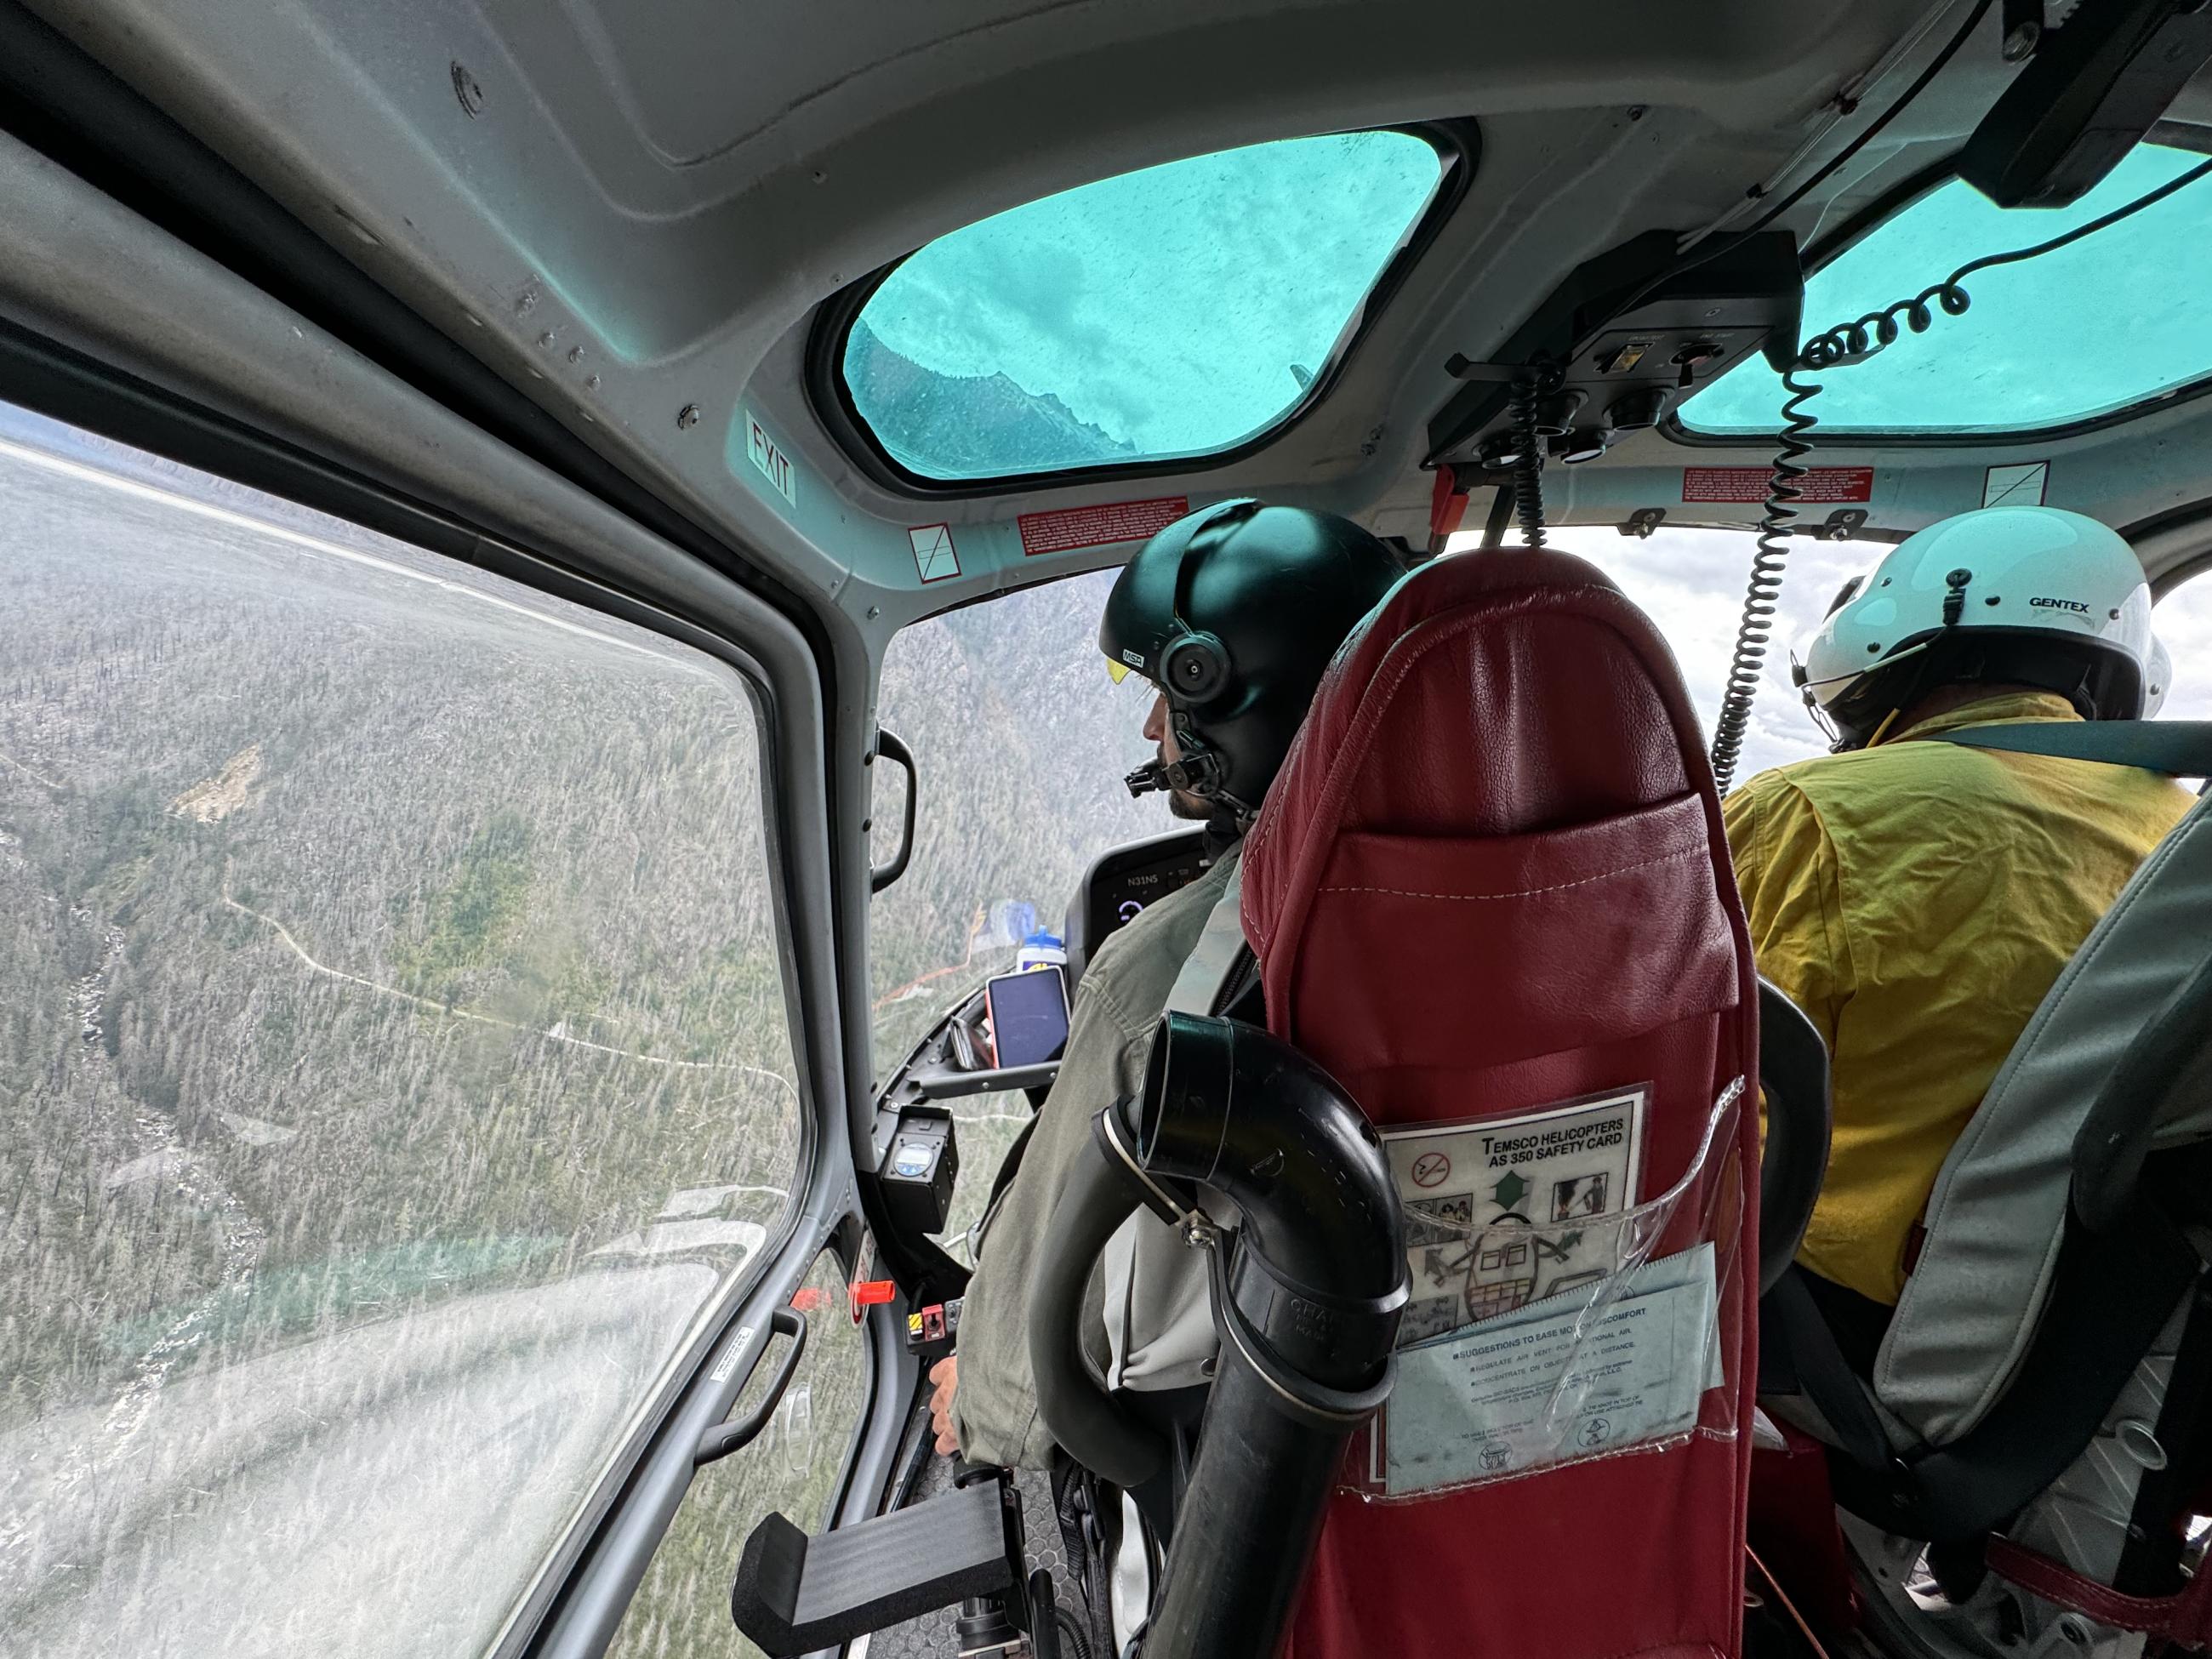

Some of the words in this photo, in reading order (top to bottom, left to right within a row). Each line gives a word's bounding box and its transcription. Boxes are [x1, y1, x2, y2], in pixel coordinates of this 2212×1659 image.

[753, 421, 790, 495] EXIT
[2029, 597, 2090, 613] GENTEX
[1124, 650, 1142, 665] MSA
[1482, 1136, 1538, 1155] TEMSCO
[1542, 1119, 1623, 1145] HELICOPTERS
[1489, 1154, 1508, 1167] AS
[1510, 1150, 1533, 1165] 350
[1536, 1140, 1584, 1160] SAFETY
[1587, 1132, 1622, 1149] CARD
[1460, 1338, 1520, 1359] SUGGESTIONS
[1523, 1335, 1534, 1344] TO
[1536, 1329, 1558, 1342] EASE
